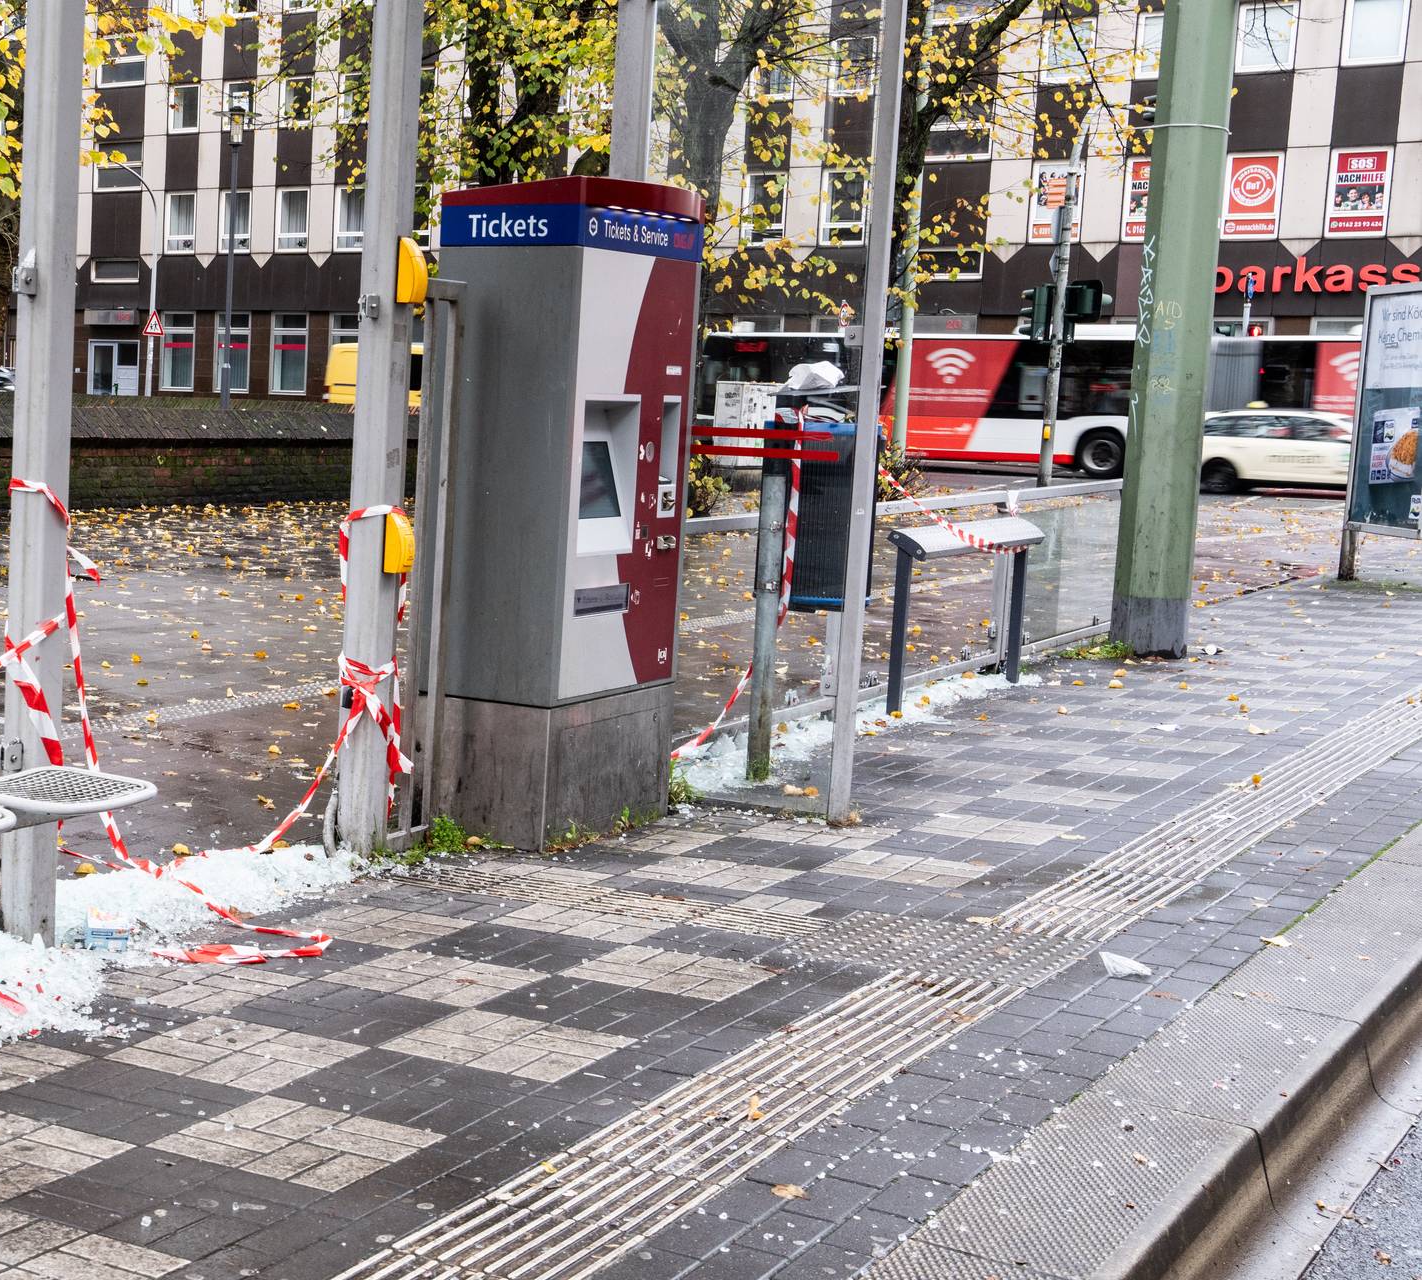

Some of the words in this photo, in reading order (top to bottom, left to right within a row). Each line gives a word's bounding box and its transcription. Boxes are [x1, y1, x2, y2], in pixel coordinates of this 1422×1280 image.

[1350, 158, 1374, 169] SOS
[1337, 172, 1384, 183] NACHHILFE
[468, 212, 548, 238] Tickets
[603, 219, 631, 241] Tickets
[633, 224, 639, 242] &
[640, 225, 669, 247] Service
[1392, 305, 1406, 322] sind
[1378, 329, 1396, 344] Keine
